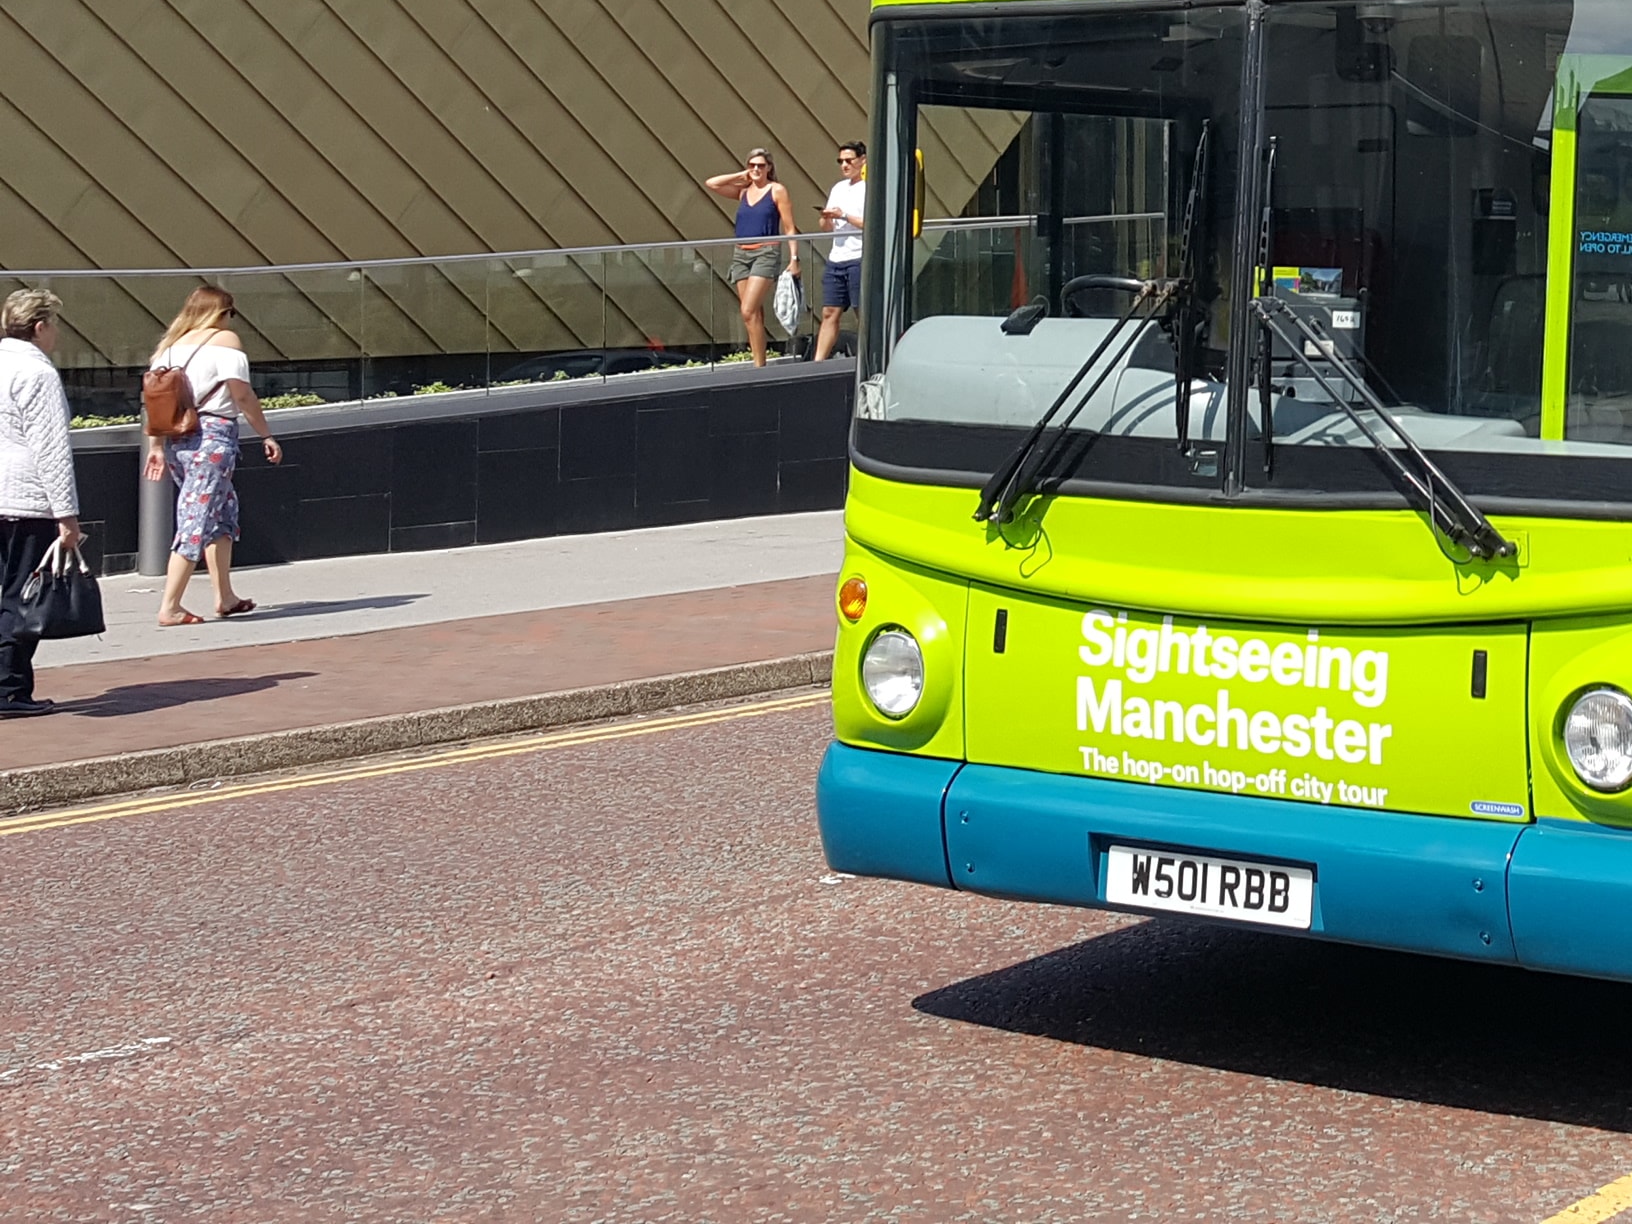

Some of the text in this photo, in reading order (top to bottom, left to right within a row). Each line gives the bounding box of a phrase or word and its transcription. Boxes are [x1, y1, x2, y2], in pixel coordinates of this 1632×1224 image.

[1079, 609, 1389, 708] Sightseeing
[1076, 676, 1393, 766] Manchester
[1080, 746, 1388, 807] The hop-on hop-off city tour
[1474, 802, 1520, 815] SCREENWASH
[1131, 853, 1291, 914] W501 RBB
